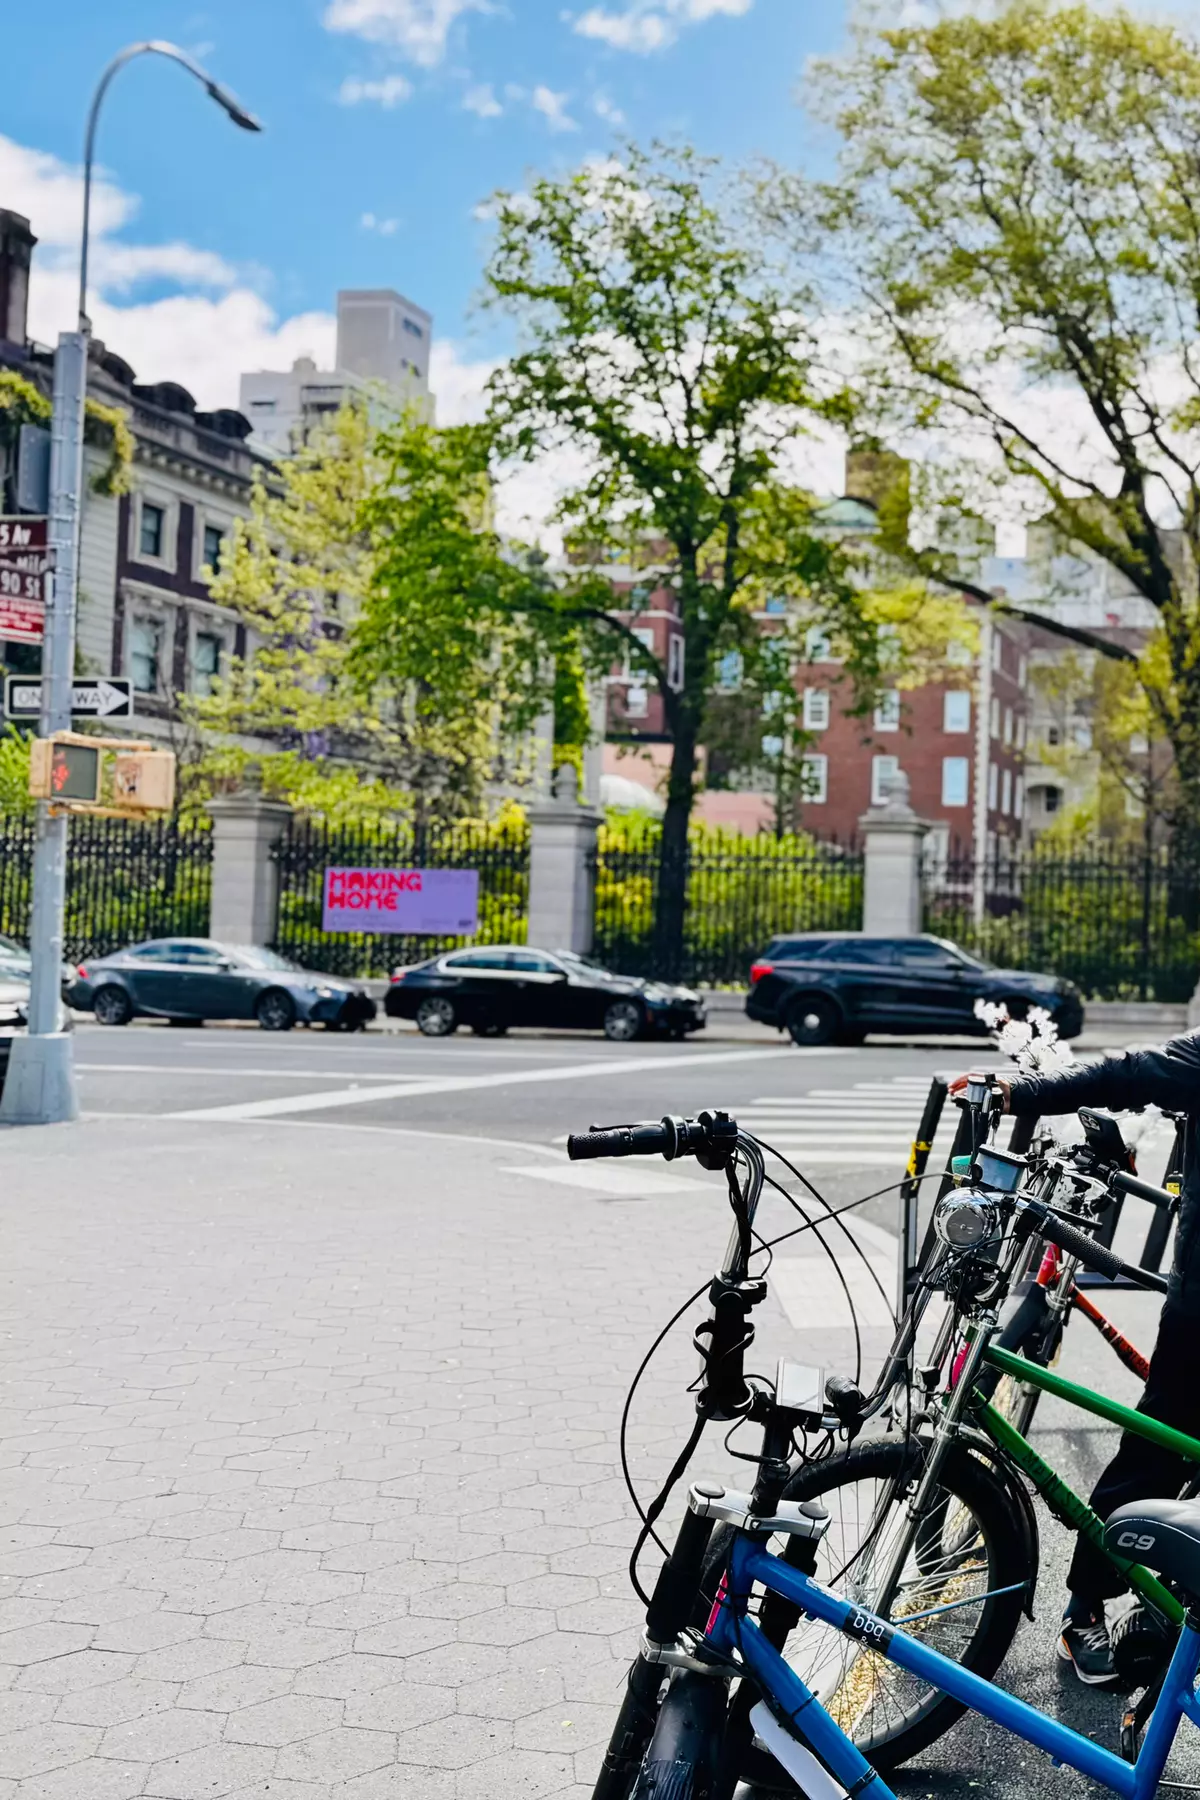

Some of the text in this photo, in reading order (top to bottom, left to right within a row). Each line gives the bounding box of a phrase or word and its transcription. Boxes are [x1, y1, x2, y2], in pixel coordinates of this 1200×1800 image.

[12, 524, 31, 545] Av
[1, 570, 41, 599] 90 St
[18, 690, 113, 705] ON WAY
[329, 871, 422, 892] MAKING
[328, 891, 399, 911] HOME
[1117, 1531, 1156, 1550] C9
[853, 1611, 885, 1643] bbq
